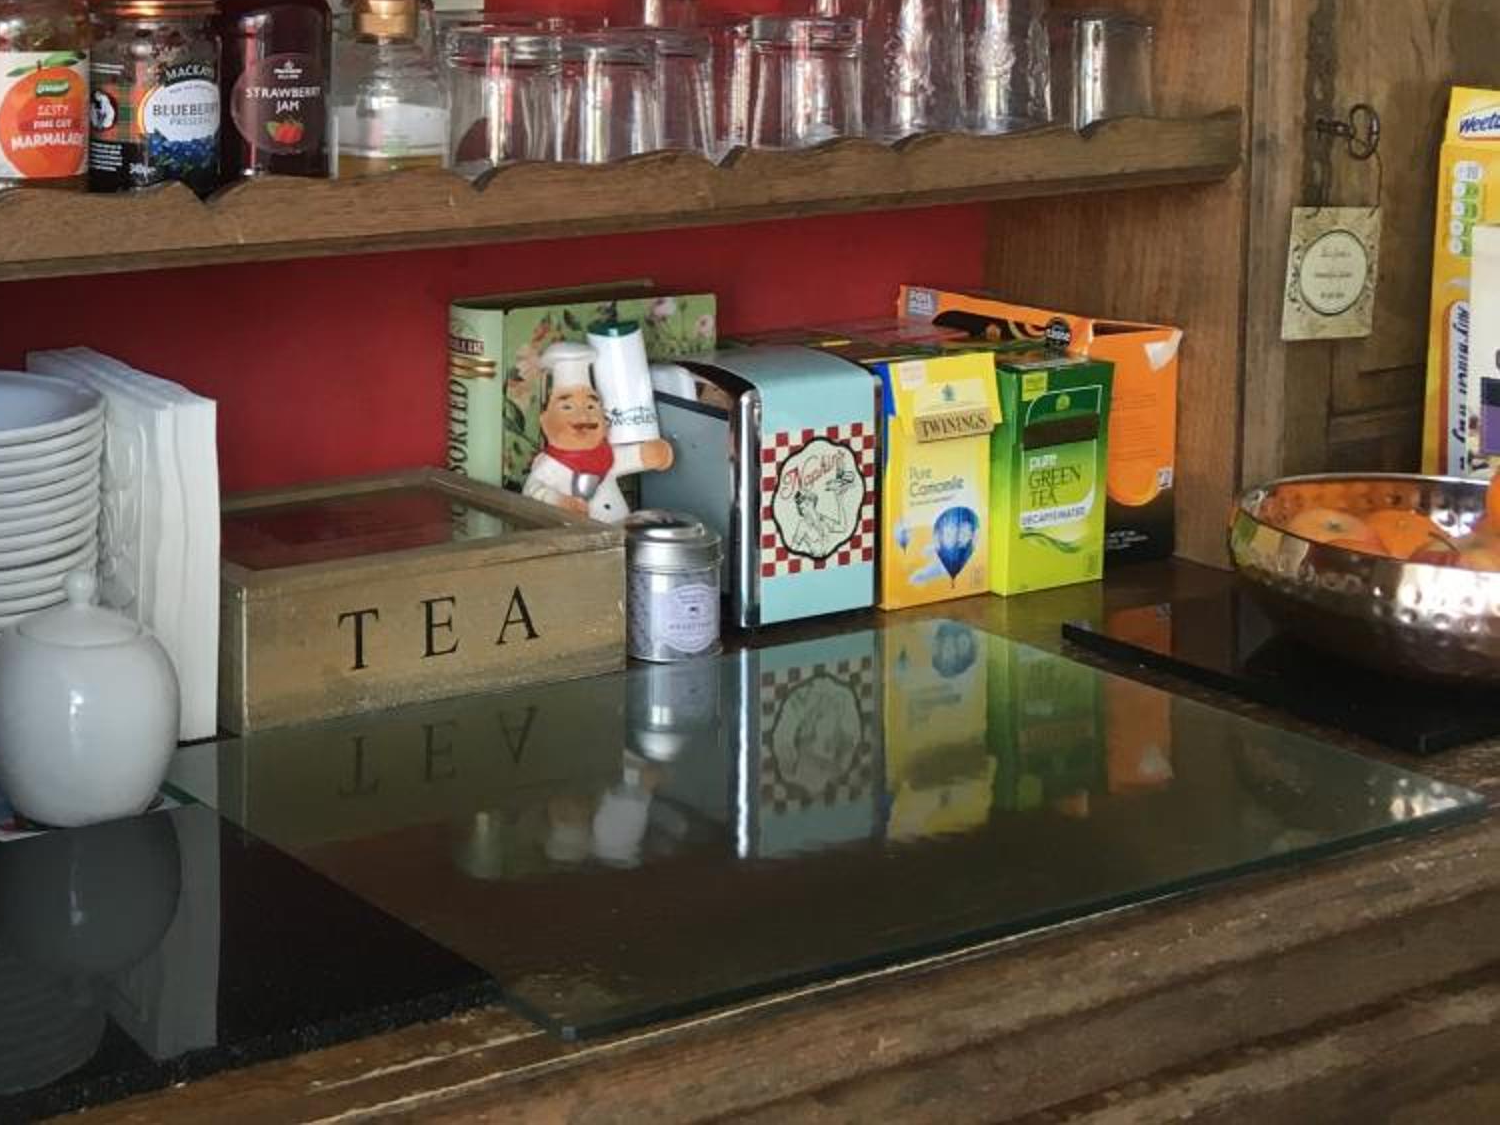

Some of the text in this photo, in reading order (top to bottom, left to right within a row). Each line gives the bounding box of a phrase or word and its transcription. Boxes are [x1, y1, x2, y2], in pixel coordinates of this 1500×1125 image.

[245, 86, 321, 99] STRAWBERRY
[276, 99, 300, 114] JAM
[920, 412, 988, 438] TWININGS
[1028, 463, 1083, 490] GREEN
[1029, 486, 1059, 507] TEA
[338, 585, 540, 671] TEA
